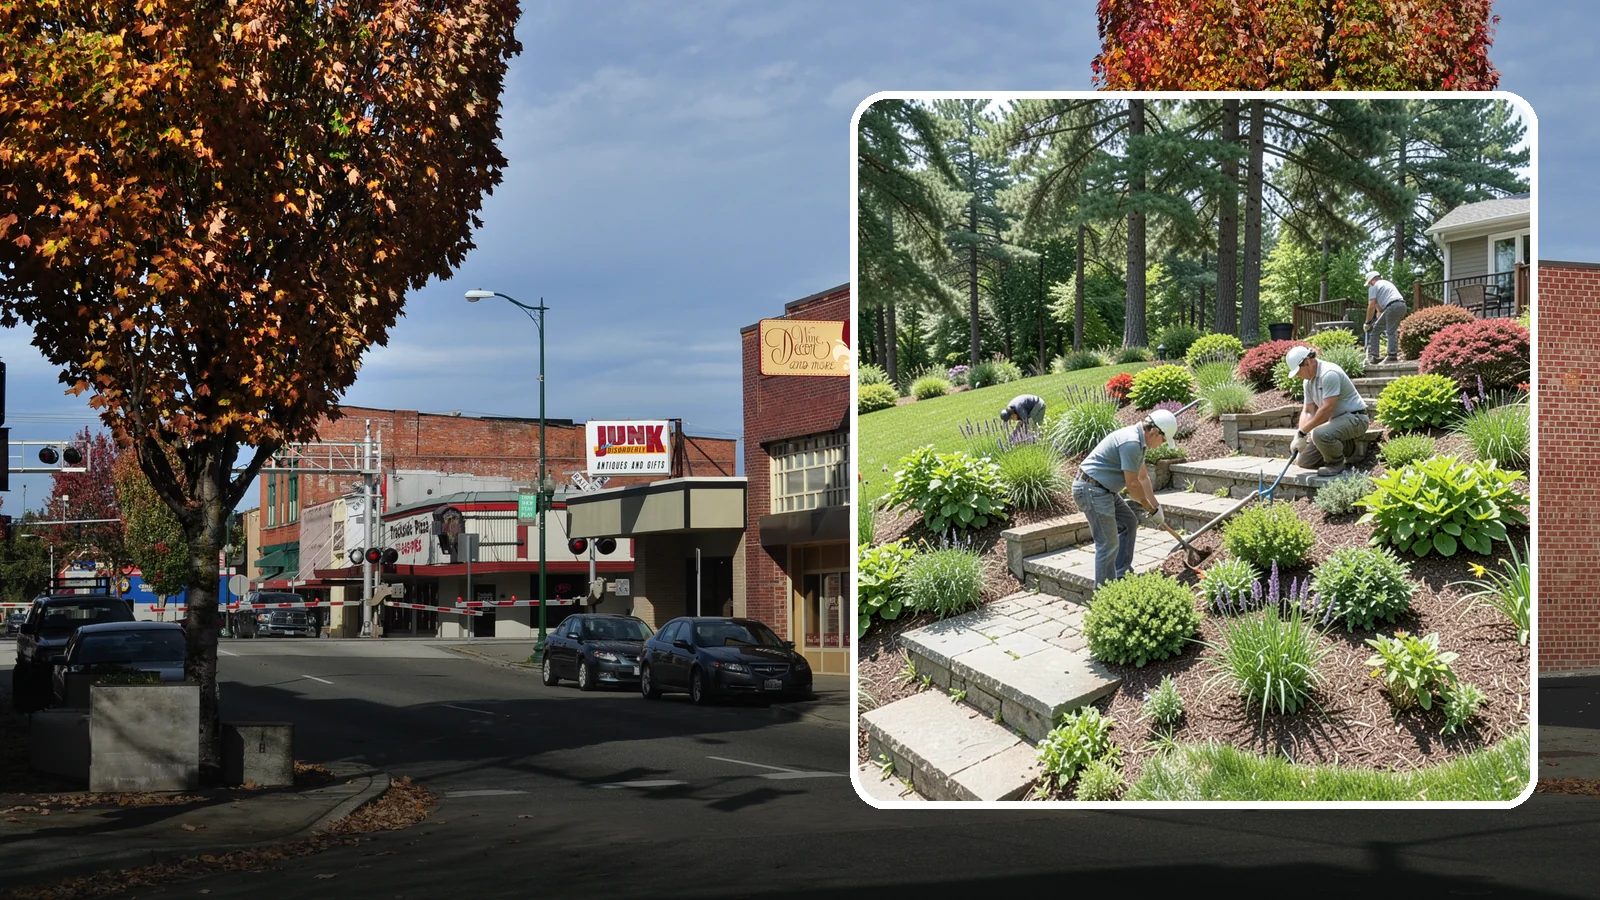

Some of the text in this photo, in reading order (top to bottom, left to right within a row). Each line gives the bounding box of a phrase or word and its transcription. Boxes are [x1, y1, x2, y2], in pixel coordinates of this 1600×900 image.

[765, 328, 831, 366] Decor
[595, 425, 665, 457] JUNK
[607, 446, 646, 454] DISORDERLY
[597, 461, 665, 470] ANTIQUES AND GIFTS
[390, 519, 429, 540] Trackside Pizza
